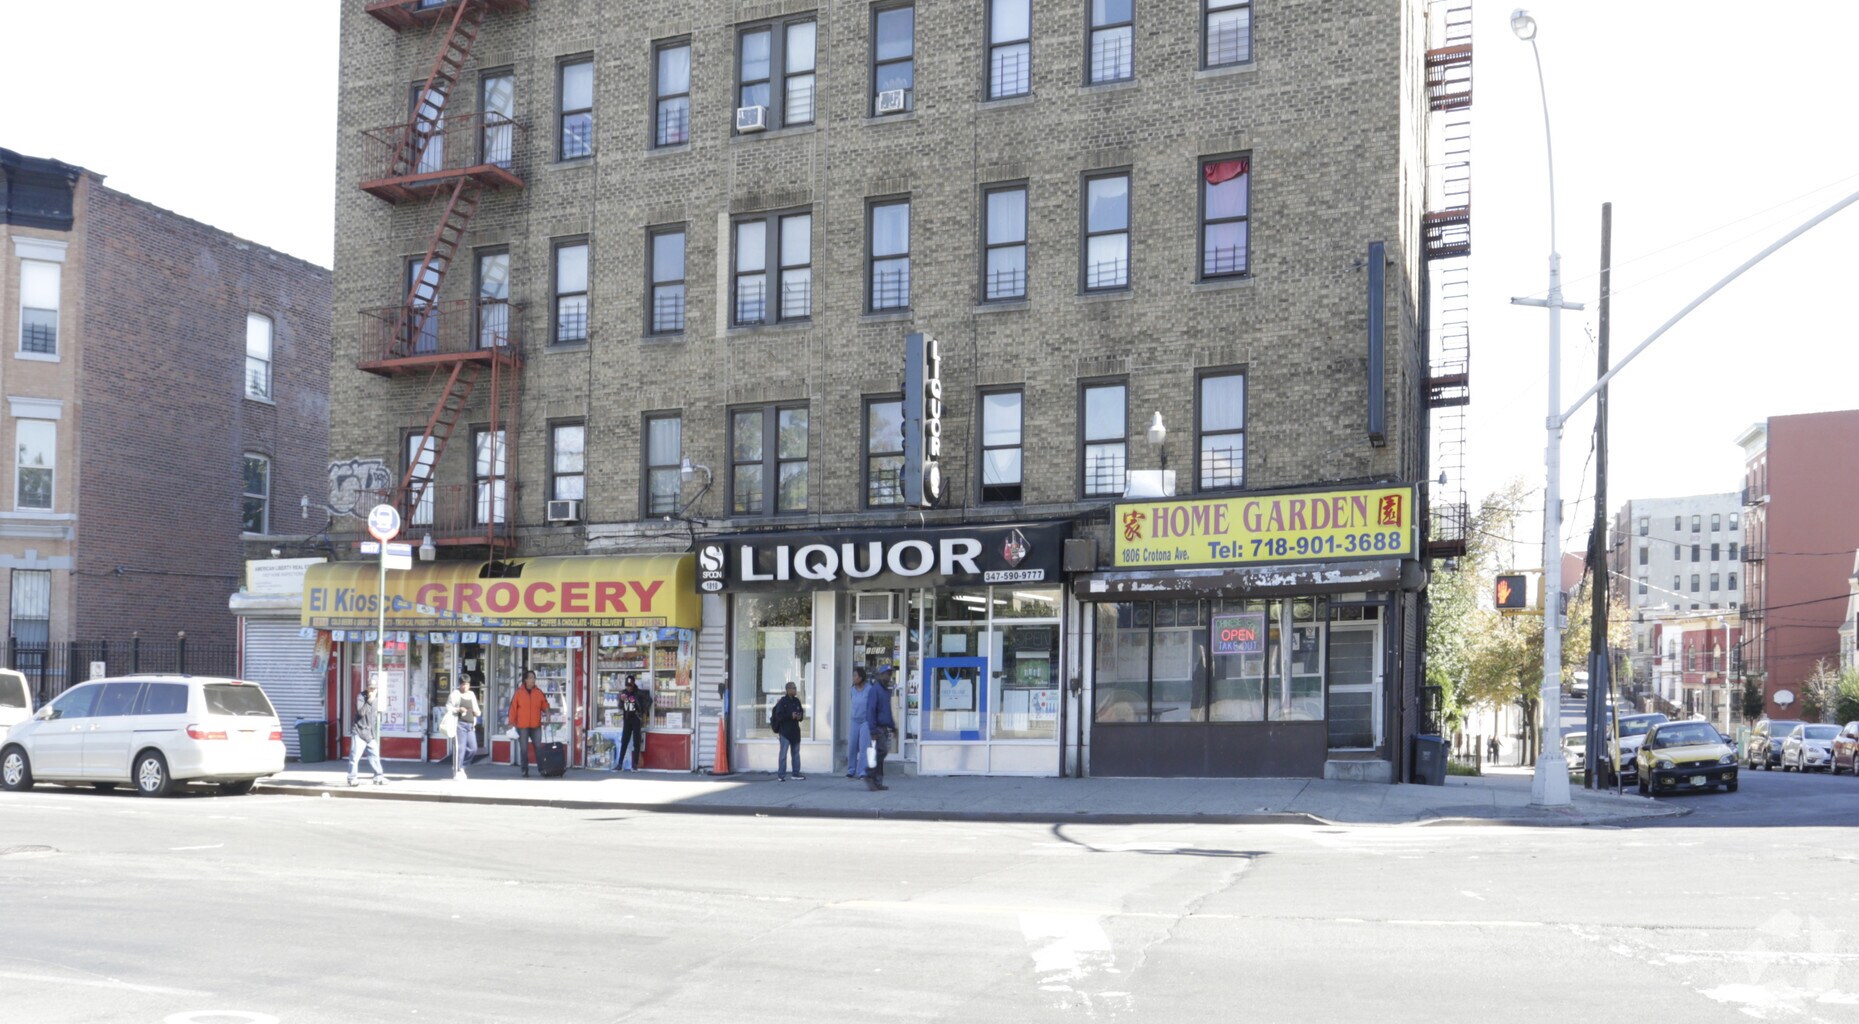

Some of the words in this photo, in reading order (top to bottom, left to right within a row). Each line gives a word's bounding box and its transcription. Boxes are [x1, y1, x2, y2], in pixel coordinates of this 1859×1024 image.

[930, 339, 942, 457] LIQUOR
[1122, 509, 1146, 542] 家
[1151, 503, 1229, 539] HOME
[1242, 495, 1368, 533] GARDEN
[1208, 541, 1243, 559] Tel:
[1251, 531, 1401, 557] 718-901-3688
[741, 538, 983, 582] LIQUOR
[1122, 548, 1140, 563] 1806
[1143, 547, 1171, 562] Crotona
[1175, 546, 1190, 561] Ave.
[702, 571, 722, 579] SPOON
[985, 569, 1044, 582] 347-590-9777
[706, 582, 718, 590] 1810
[310, 588, 328, 612] El
[416, 580, 664, 614] GROCERY
[561, 618, 587, 626] CHOCOLATE
[589, 618, 601, 626] FREE
[602, 618, 623, 626] DELIVERY
[1014, 629, 1051, 647] OPEN
[1221, 628, 1255, 641] OPEN
[1219, 641, 1238, 651] TAKE
